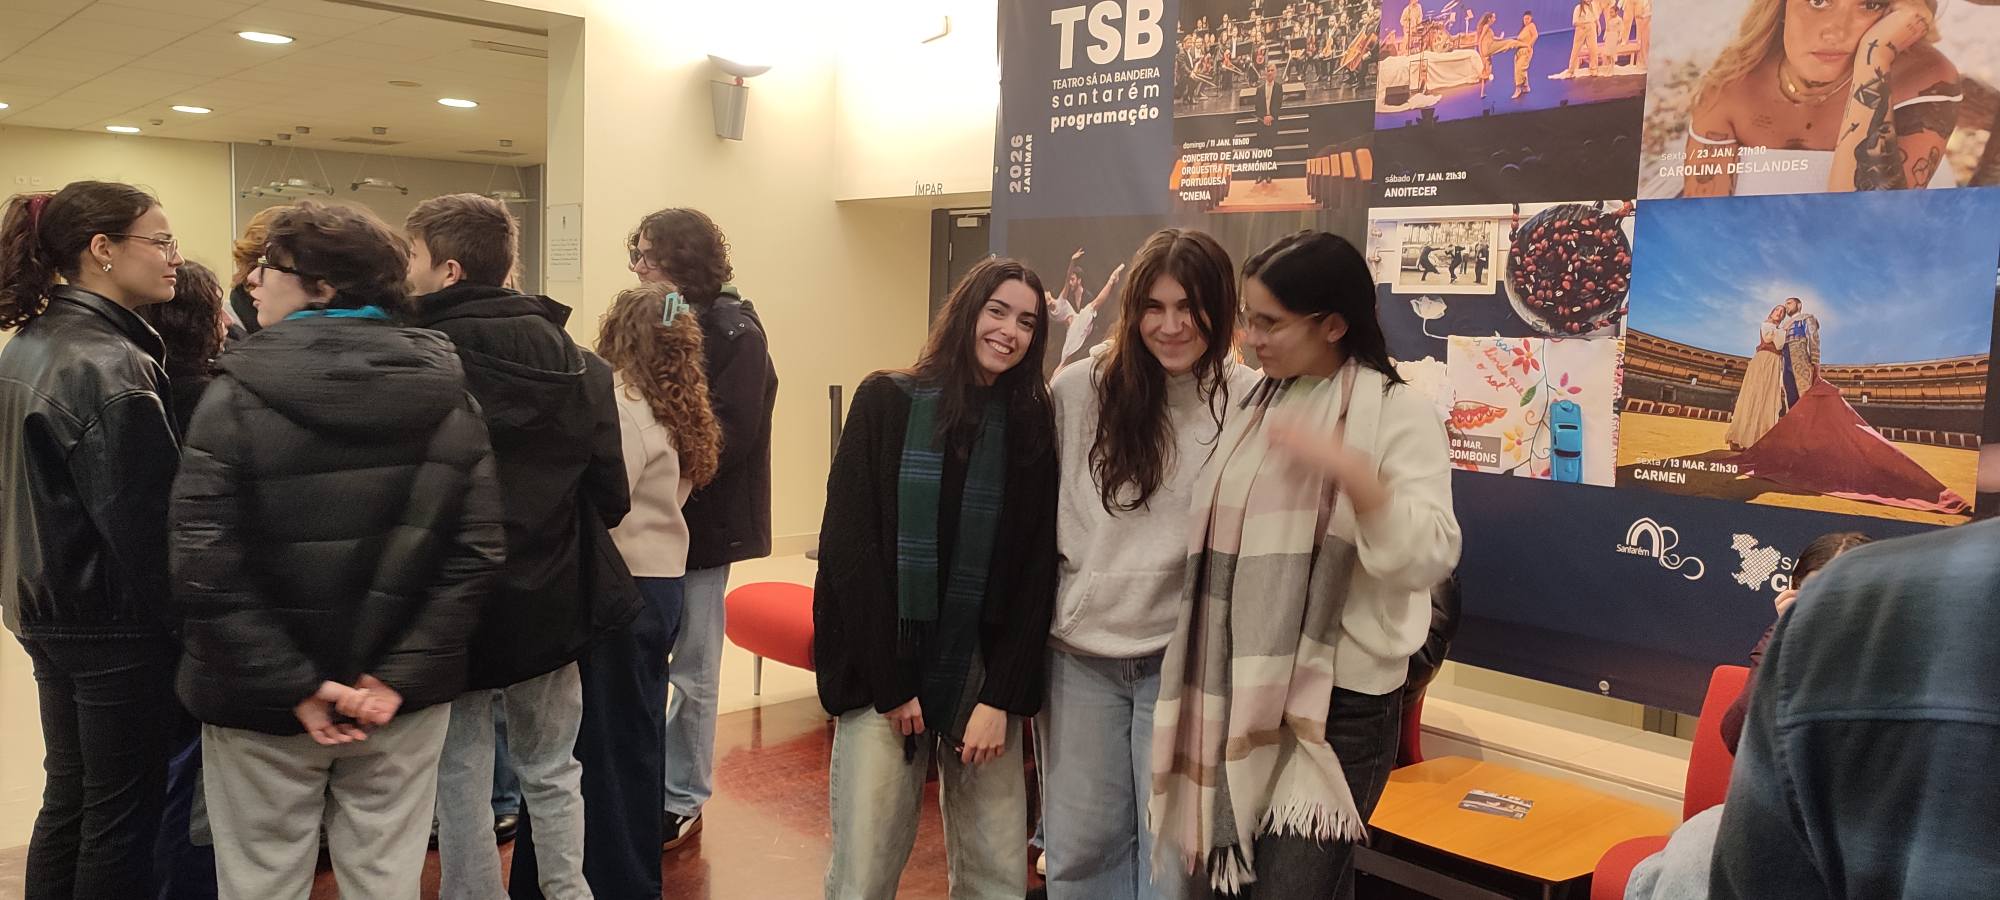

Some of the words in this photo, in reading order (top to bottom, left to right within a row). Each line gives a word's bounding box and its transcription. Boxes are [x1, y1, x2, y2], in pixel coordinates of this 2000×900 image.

[1050, 0, 1164, 70] TSB
[1052, 77, 1085, 91] TEATRO
[1086, 72, 1098, 86] SÁ
[1100, 73, 1112, 84] DA
[1114, 67, 1160, 82] BANDEIRA
[1052, 82, 1160, 108] santarém
[1050, 104, 1160, 133] programação
[1183, 141, 1206, 149] domingo
[1216, 139, 1231, 147] JAN.
[1182, 152, 1218, 163] CONCERTO
[1220, 152, 1231, 160] DE
[1232, 151, 1250, 160] ANO
[1252, 149, 1272, 159] NOVO
[1661, 151, 1687, 161] sexta
[1697, 149, 1709, 159] 23
[1711, 148, 1735, 158] JAN.
[1737, 145, 1767, 157] 21h30
[1009, 135, 1024, 193] 2026
[1182, 165, 1222, 175] ORQUESTRA
[1225, 160, 1277, 173] FILARMÓNICA
[1659, 163, 1723, 177] CAROLINA
[1727, 159, 1809, 174] DESLANDES
[1181, 176, 1226, 187] PORTUGUESA
[1384, 174, 1411, 183] sábado
[1417, 173, 1425, 182] 17
[1426, 172, 1444, 181] JAN.
[1445, 171, 1467, 180] 21h30
[914, 180, 943, 197] ÍMPAR
[1384, 186, 1438, 198] ANOITECER
[1463, 440, 1483, 450] MAR.
[1450, 449, 1497, 463] BOMBONS
[1637, 457, 1661, 466] sexta
[1670, 458, 1679, 468] 13
[1682, 460, 1708, 471] MAR.
[1709, 462, 1738, 474] 21h30
[1634, 469, 1686, 484] CARMEN
[1616, 543, 1650, 557] Santarém
